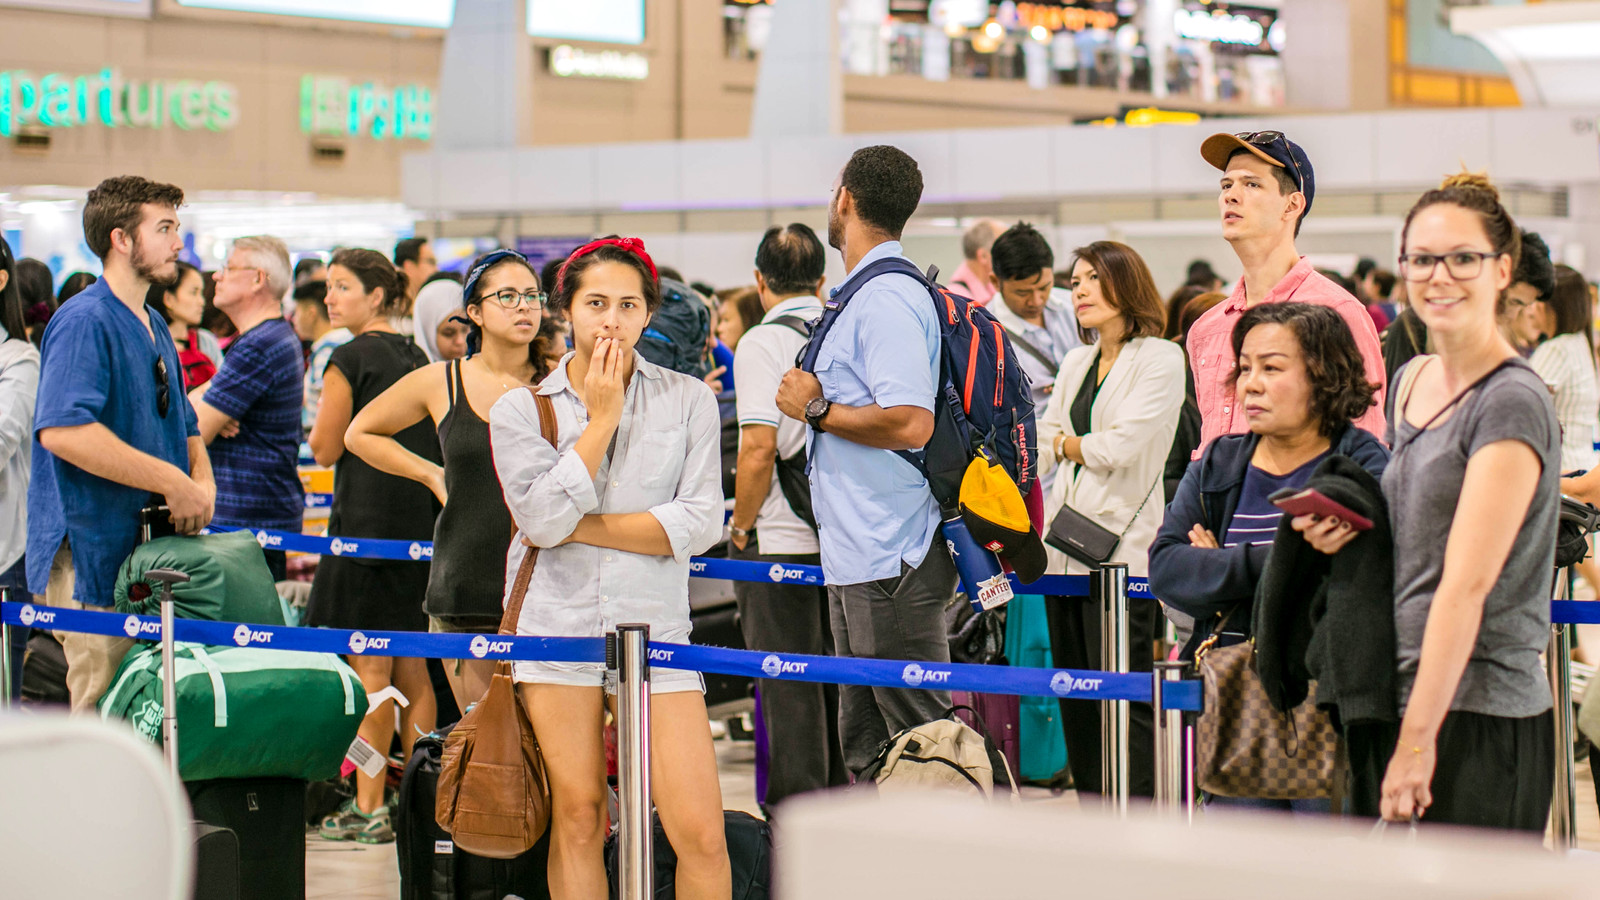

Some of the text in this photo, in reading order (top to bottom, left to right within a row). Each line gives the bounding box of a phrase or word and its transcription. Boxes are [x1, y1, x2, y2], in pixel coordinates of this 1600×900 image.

[1016, 423, 1029, 483] patagonia
[266, 535, 283, 546] AOT
[341, 543, 359, 553] AOT
[421, 546, 434, 556] AO
[783, 569, 804, 579] AOT
[1127, 582, 1150, 592] AOT
[35, 611, 56, 624] AOT
[140, 622, 162, 634] AOT
[250, 631, 274, 643] AOT
[366, 638, 391, 649] AOT
[488, 641, 514, 654] AOT
[649, 648, 675, 662] AOT
[781, 661, 808, 674] AOT
[923, 670, 951, 683] AOT
[1071, 678, 1102, 691] AOT
